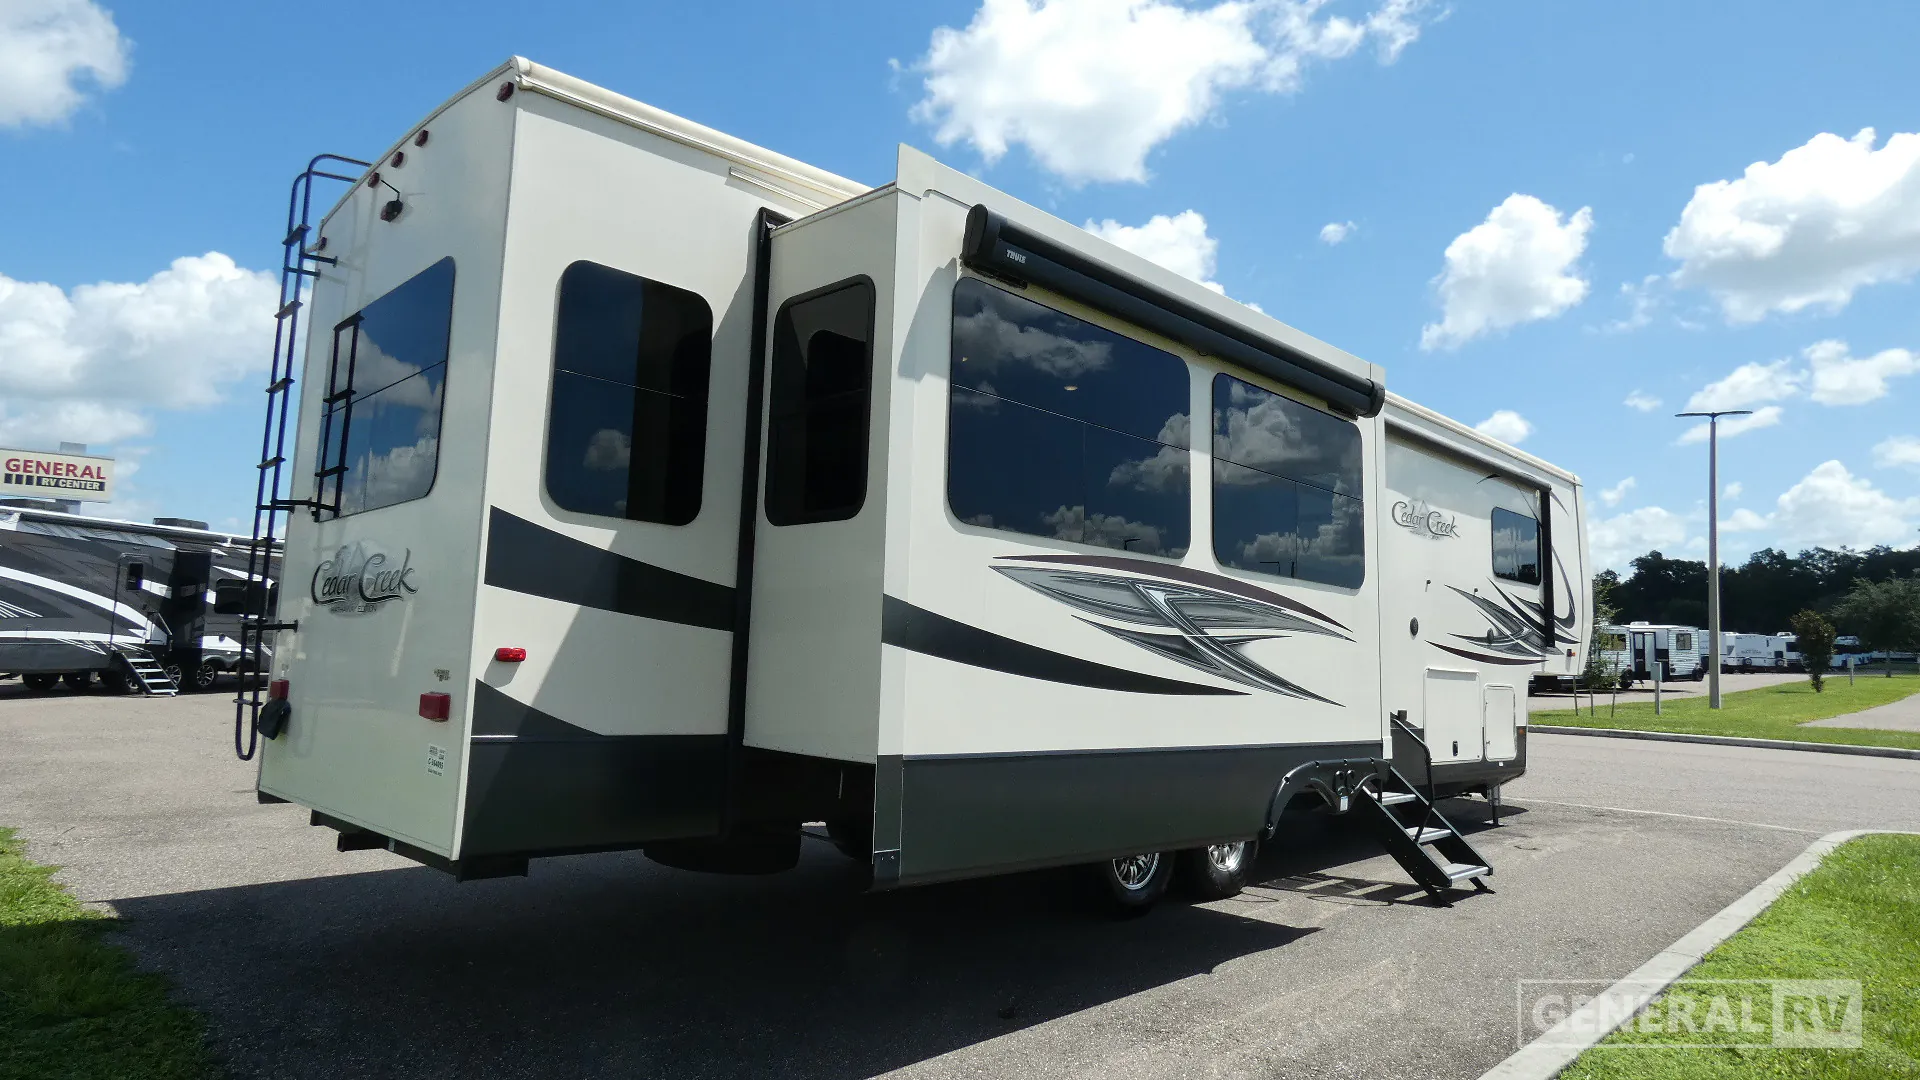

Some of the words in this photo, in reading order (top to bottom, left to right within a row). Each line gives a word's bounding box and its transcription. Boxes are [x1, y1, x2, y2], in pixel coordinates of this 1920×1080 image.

[1006, 249, 1027, 264] THULE
[5, 458, 107, 480] GENERAL
[41, 478, 58, 487] RV
[59, 479, 100, 490] CENTER
[1391, 501, 1424, 529] Cedar
[1427, 511, 1460, 538] Creek
[311, 559, 357, 606] Cedar
[358, 548, 419, 603] Creek
